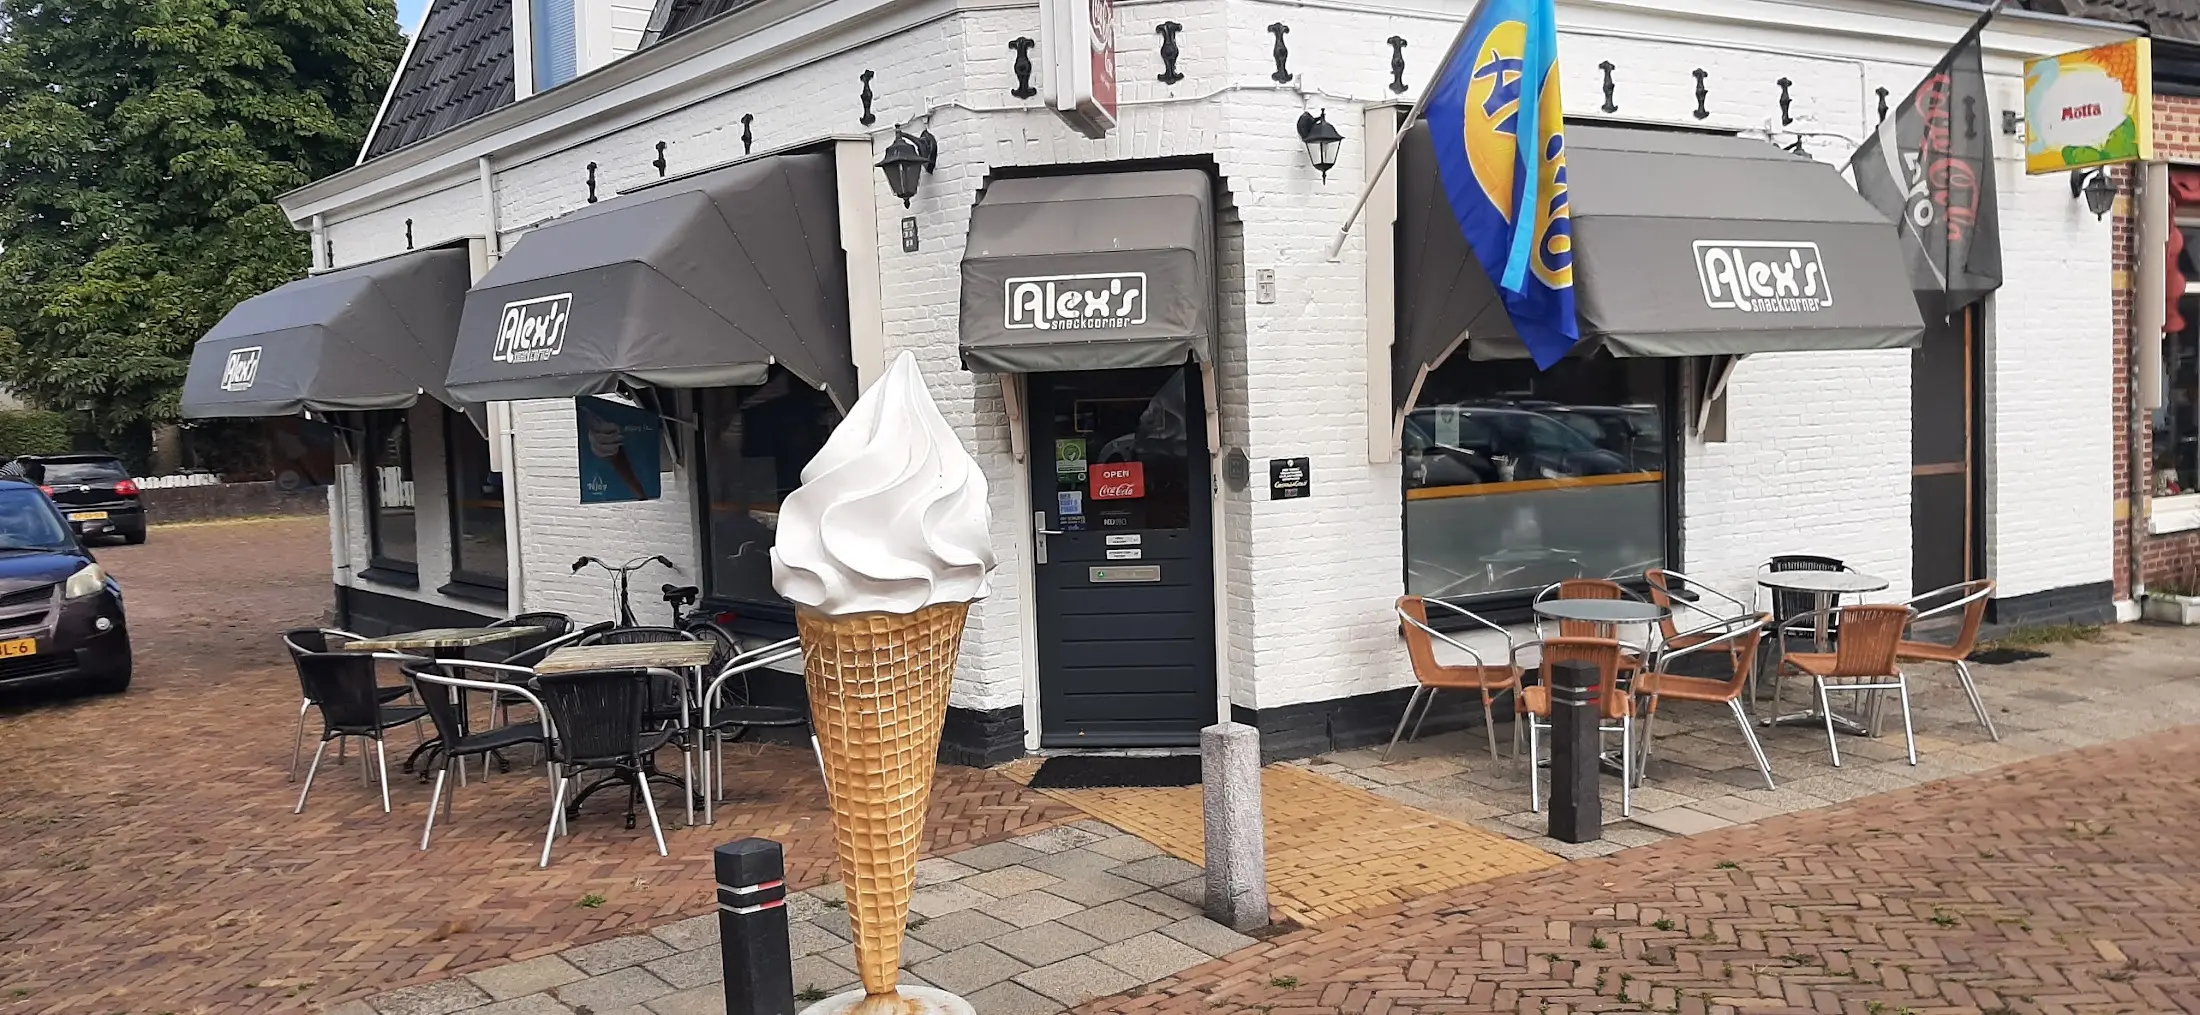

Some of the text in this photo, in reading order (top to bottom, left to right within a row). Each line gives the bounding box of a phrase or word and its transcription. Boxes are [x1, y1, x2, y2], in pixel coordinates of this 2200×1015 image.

[2061, 103, 2103, 122] Motta
[1704, 248, 1818, 312] Alex's
[1013, 278, 1140, 330] Alex's
[1751, 291, 1821, 312] snackcorner
[499, 300, 565, 364] Alex's
[1051, 313, 1131, 330] snackcorner
[1102, 469, 1131, 479] OPEN
